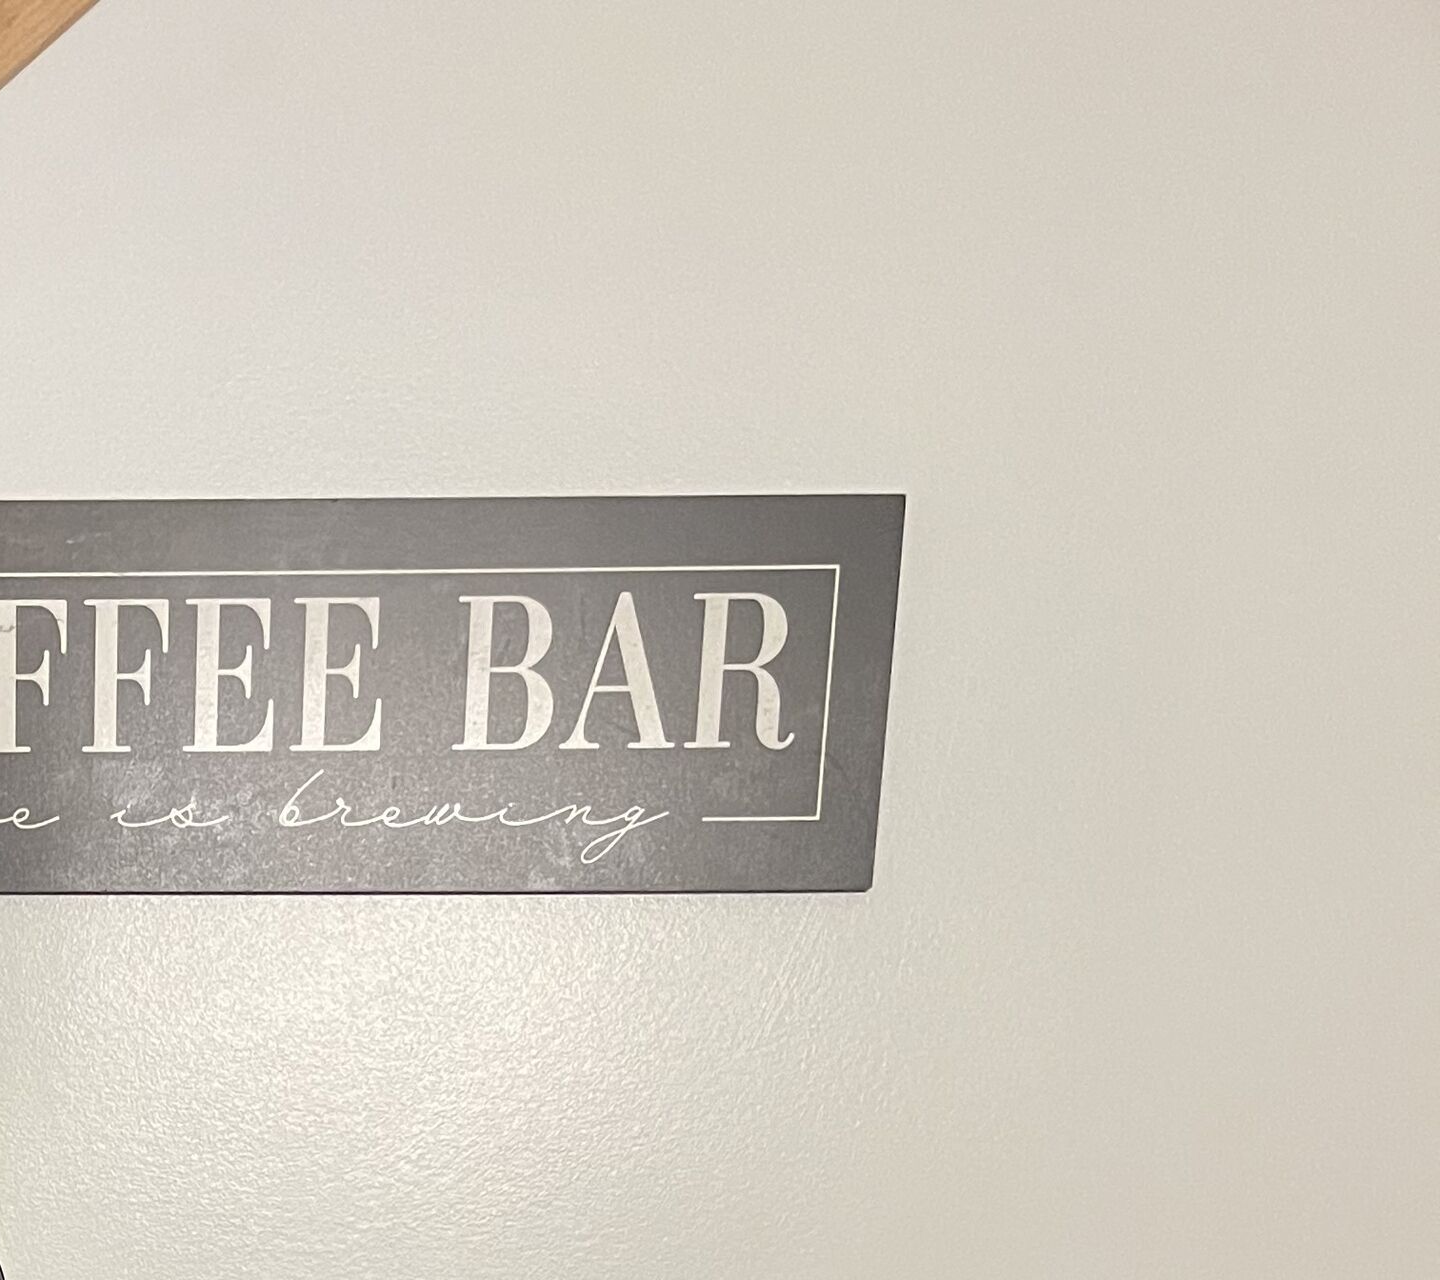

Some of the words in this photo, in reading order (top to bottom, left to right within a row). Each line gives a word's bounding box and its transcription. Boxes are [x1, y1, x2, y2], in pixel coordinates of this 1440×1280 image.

[451, 590, 796, 753] BAR
[111, 799, 228, 830] is
[278, 768, 670, 863] brewing
